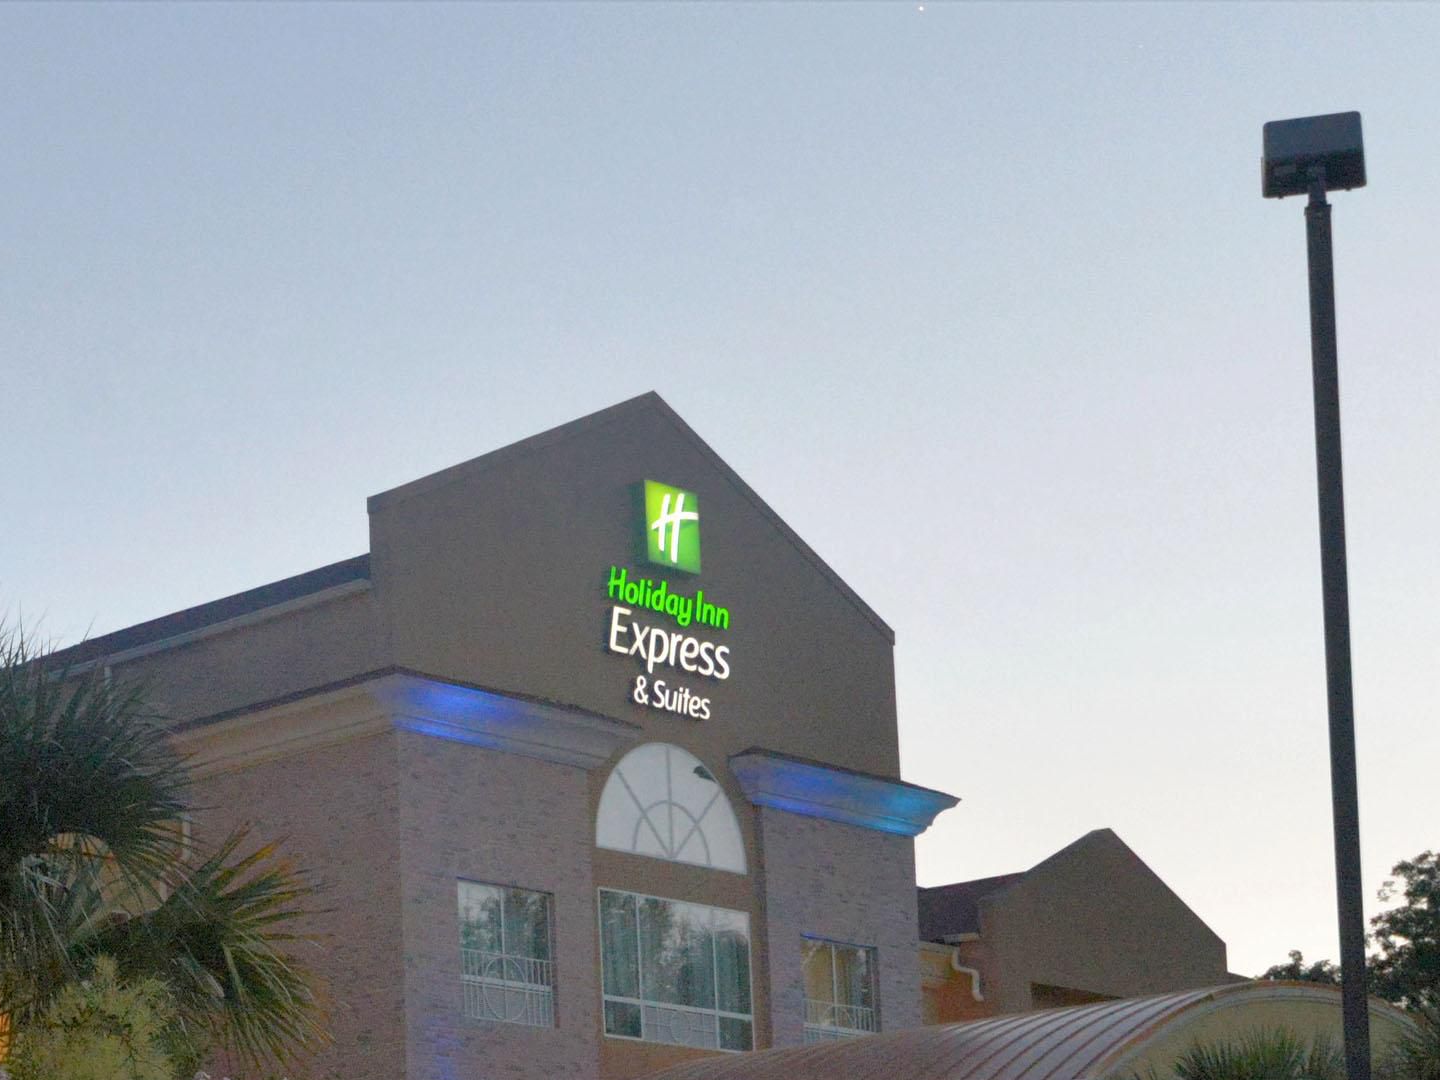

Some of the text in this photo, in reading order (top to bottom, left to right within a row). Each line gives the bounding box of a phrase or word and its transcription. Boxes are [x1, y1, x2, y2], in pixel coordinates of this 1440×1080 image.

[651, 493, 698, 563] H
[608, 566, 729, 629] Holiday Inn
[609, 606, 730, 679] Express
[633, 675, 711, 719] & Suites
